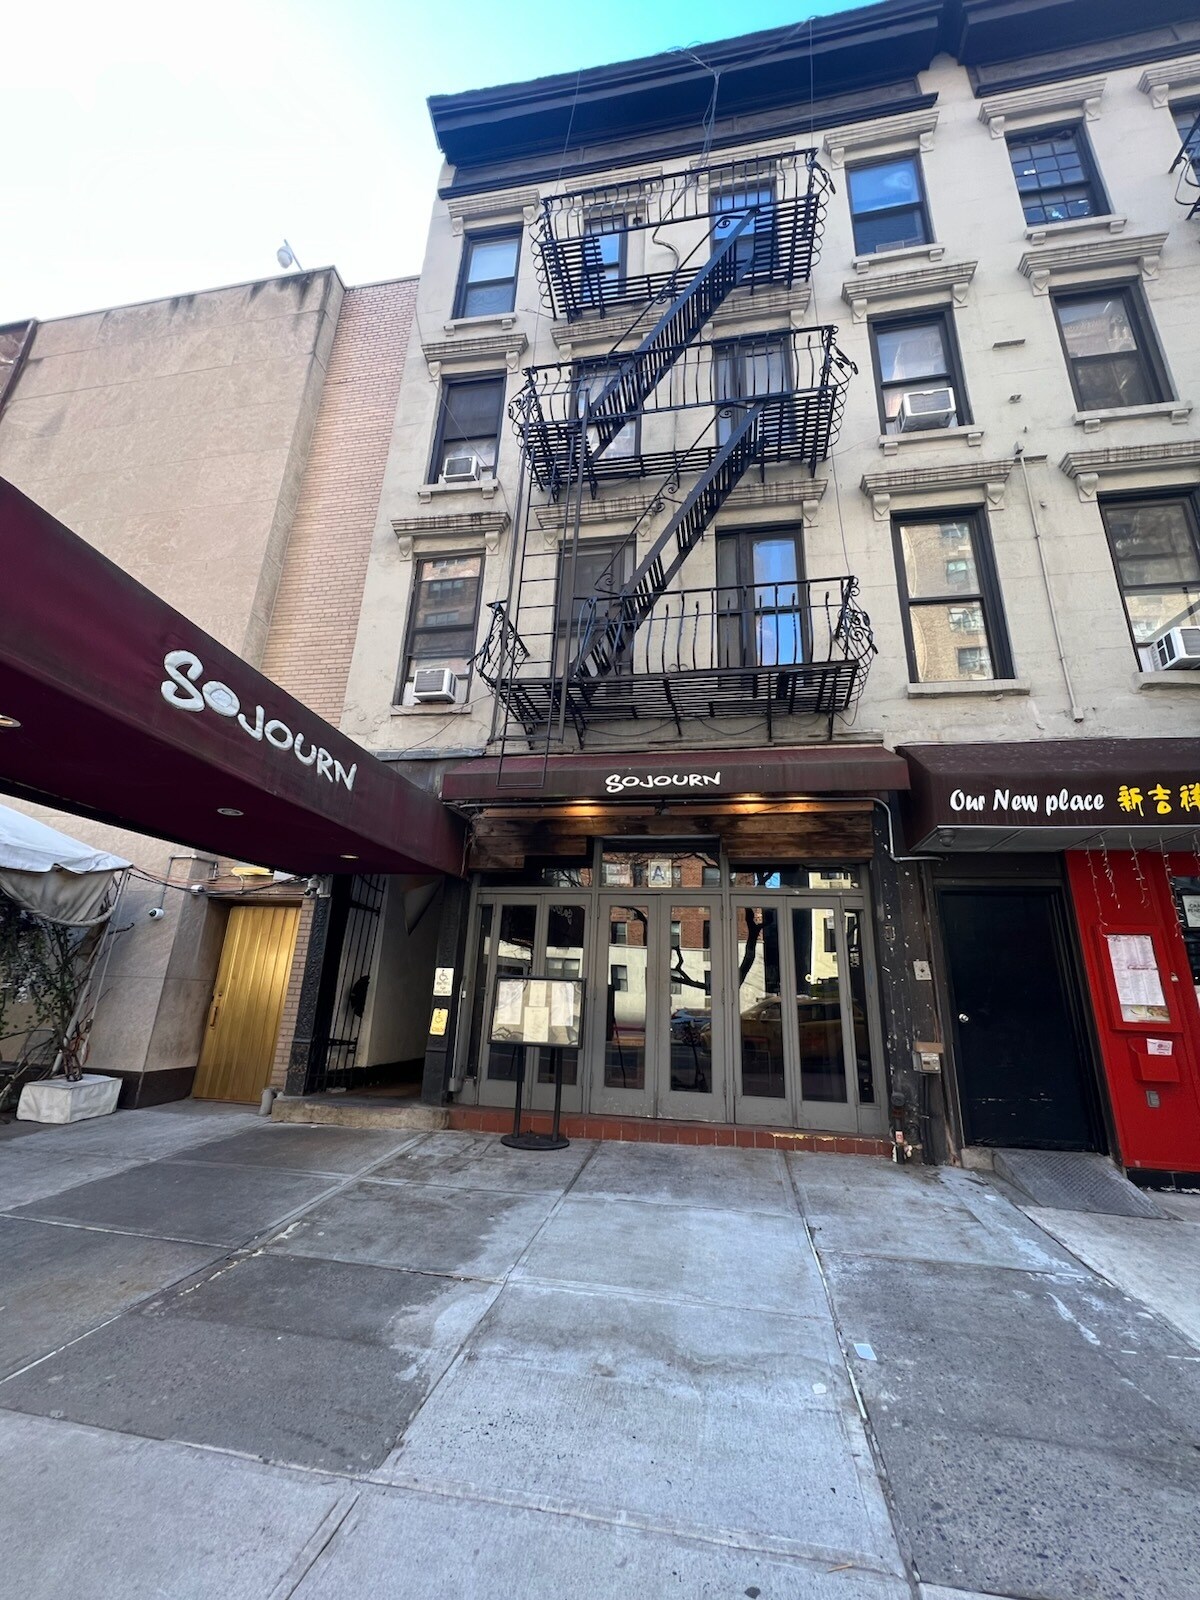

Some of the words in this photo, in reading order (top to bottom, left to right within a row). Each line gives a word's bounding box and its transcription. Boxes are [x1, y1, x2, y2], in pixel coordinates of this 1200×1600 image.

[160, 649, 358, 791] SOJOURN
[605, 771, 721, 793] SOJOURN
[949, 788, 985, 811] Our
[993, 789, 1038, 812] New
[1045, 788, 1105, 817] place
[651, 865, 665, 881] A
